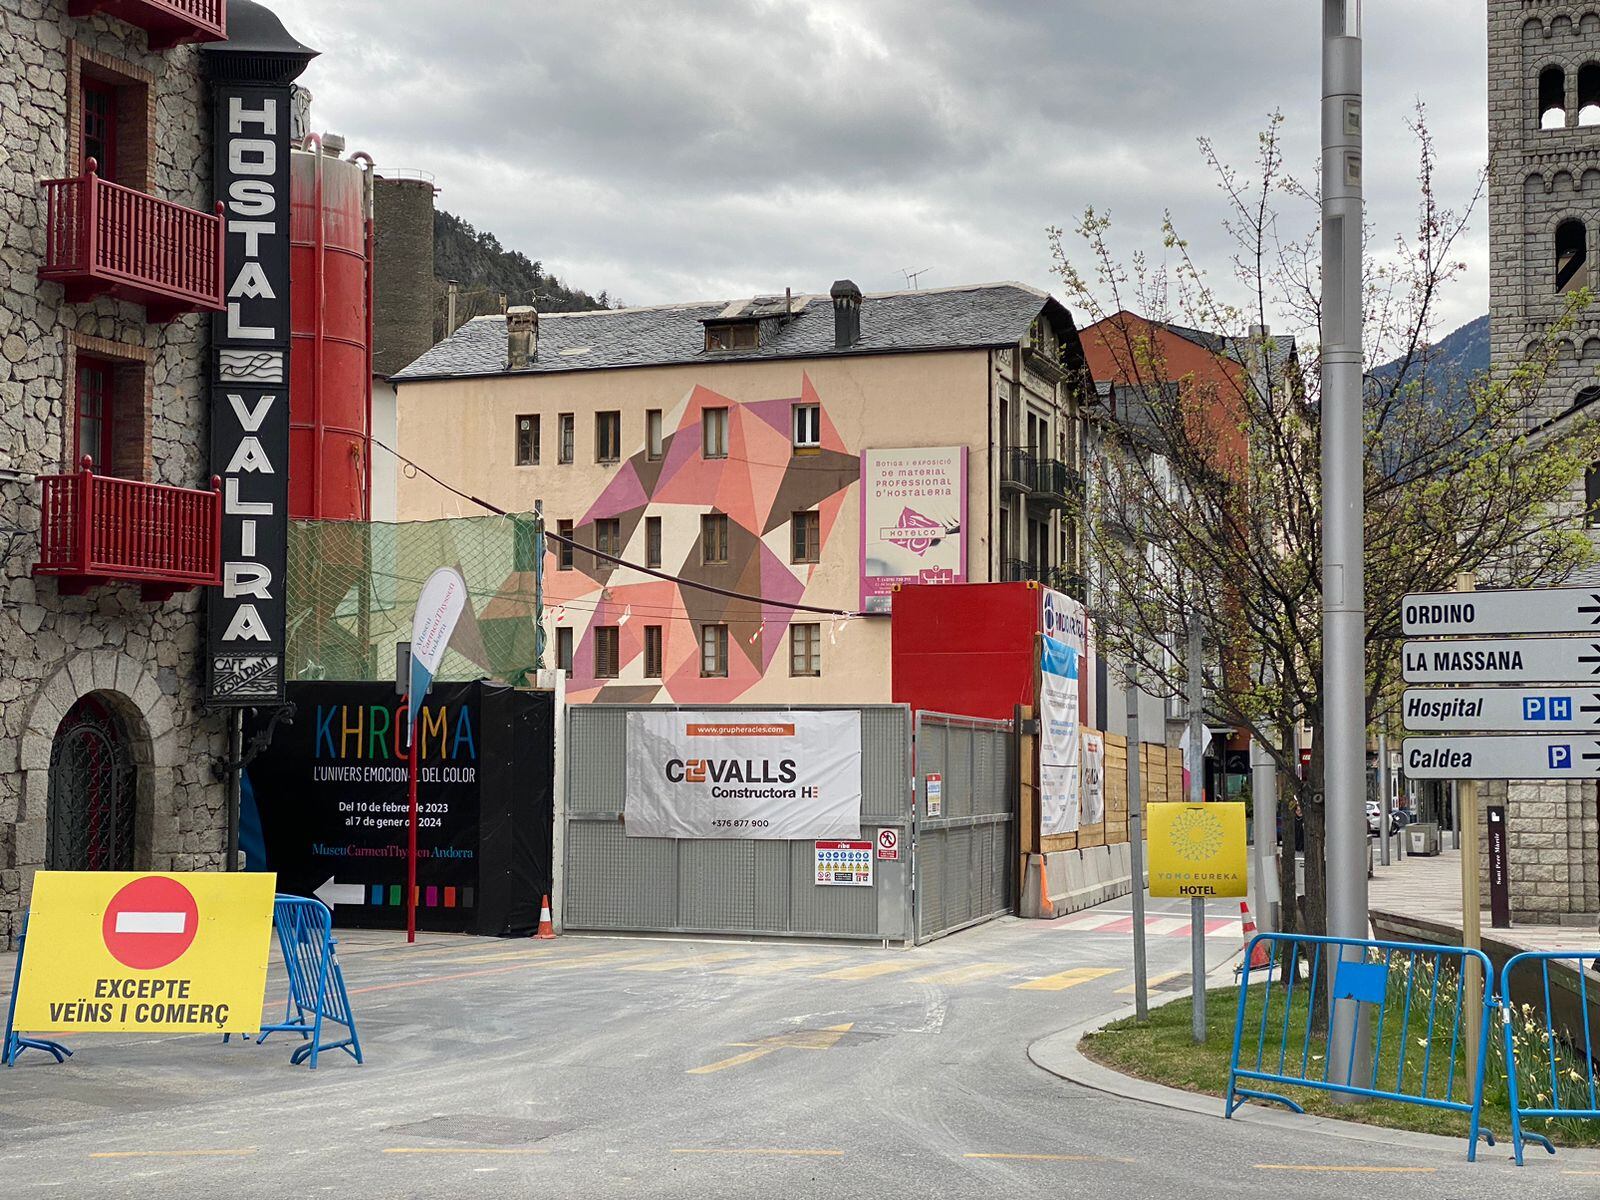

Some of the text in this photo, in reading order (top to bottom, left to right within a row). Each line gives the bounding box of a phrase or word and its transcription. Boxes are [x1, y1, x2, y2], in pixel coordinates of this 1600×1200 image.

[227, 97, 276, 340] HOSTAL
[221, 394, 276, 641] VALIRA
[1406, 604, 1475, 625] ORDINO
[1406, 651, 1523, 672] LA MASSANA
[1407, 697, 1484, 721] Hospital
[697, 725, 784, 735] www.grupheracles.com
[1409, 749, 1472, 768] Caldea
[314, 766, 476, 783] L'UNIVERS EMOCION DEL COLOR
[711, 786, 796, 798] Constructora
[339, 802, 354, 812] Del
[357, 802, 367, 812] 10
[369, 802, 381, 812] de
[425, 803, 449, 813] 2023
[345, 817, 354, 826] al
[355, 817, 361, 826] 7
[363, 817, 375, 826] de
[376, 818, 404, 828] gener
[418, 818, 442, 827] 2024
[711, 819, 769, 827] +376 877 900
[430, 846, 473, 858] Andorra
[1180, 886, 1216, 894] HOTEL
[94, 979, 191, 999] EXCEPTE
[50, 998, 229, 1029] VEÏNS I COMERÇ
